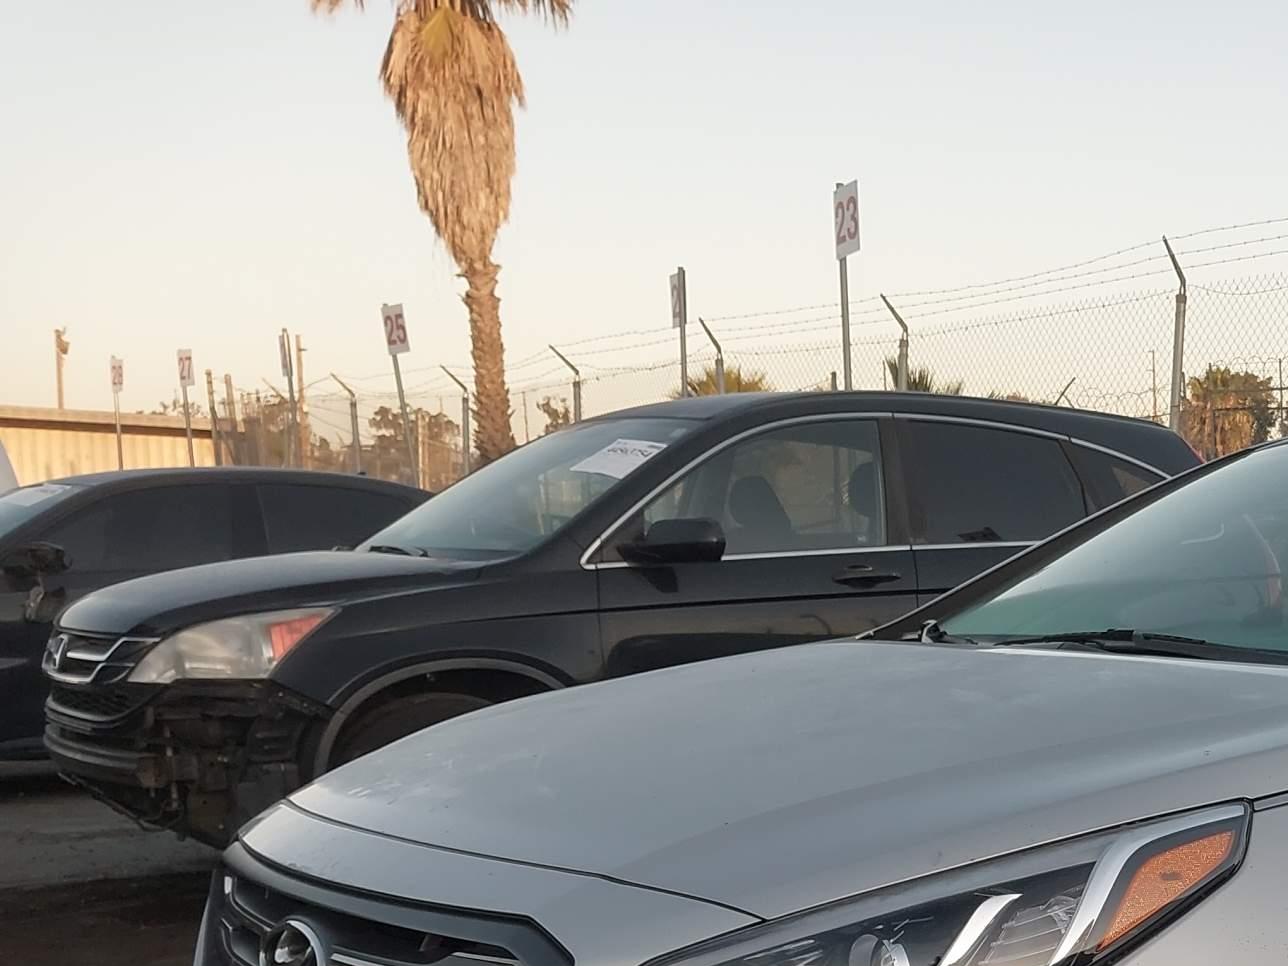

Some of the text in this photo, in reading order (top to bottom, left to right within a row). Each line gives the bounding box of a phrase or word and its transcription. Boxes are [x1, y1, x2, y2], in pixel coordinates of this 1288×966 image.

[835, 196, 857, 245] 23
[384, 313, 406, 345] 25
[178, 356, 192, 380] 27
